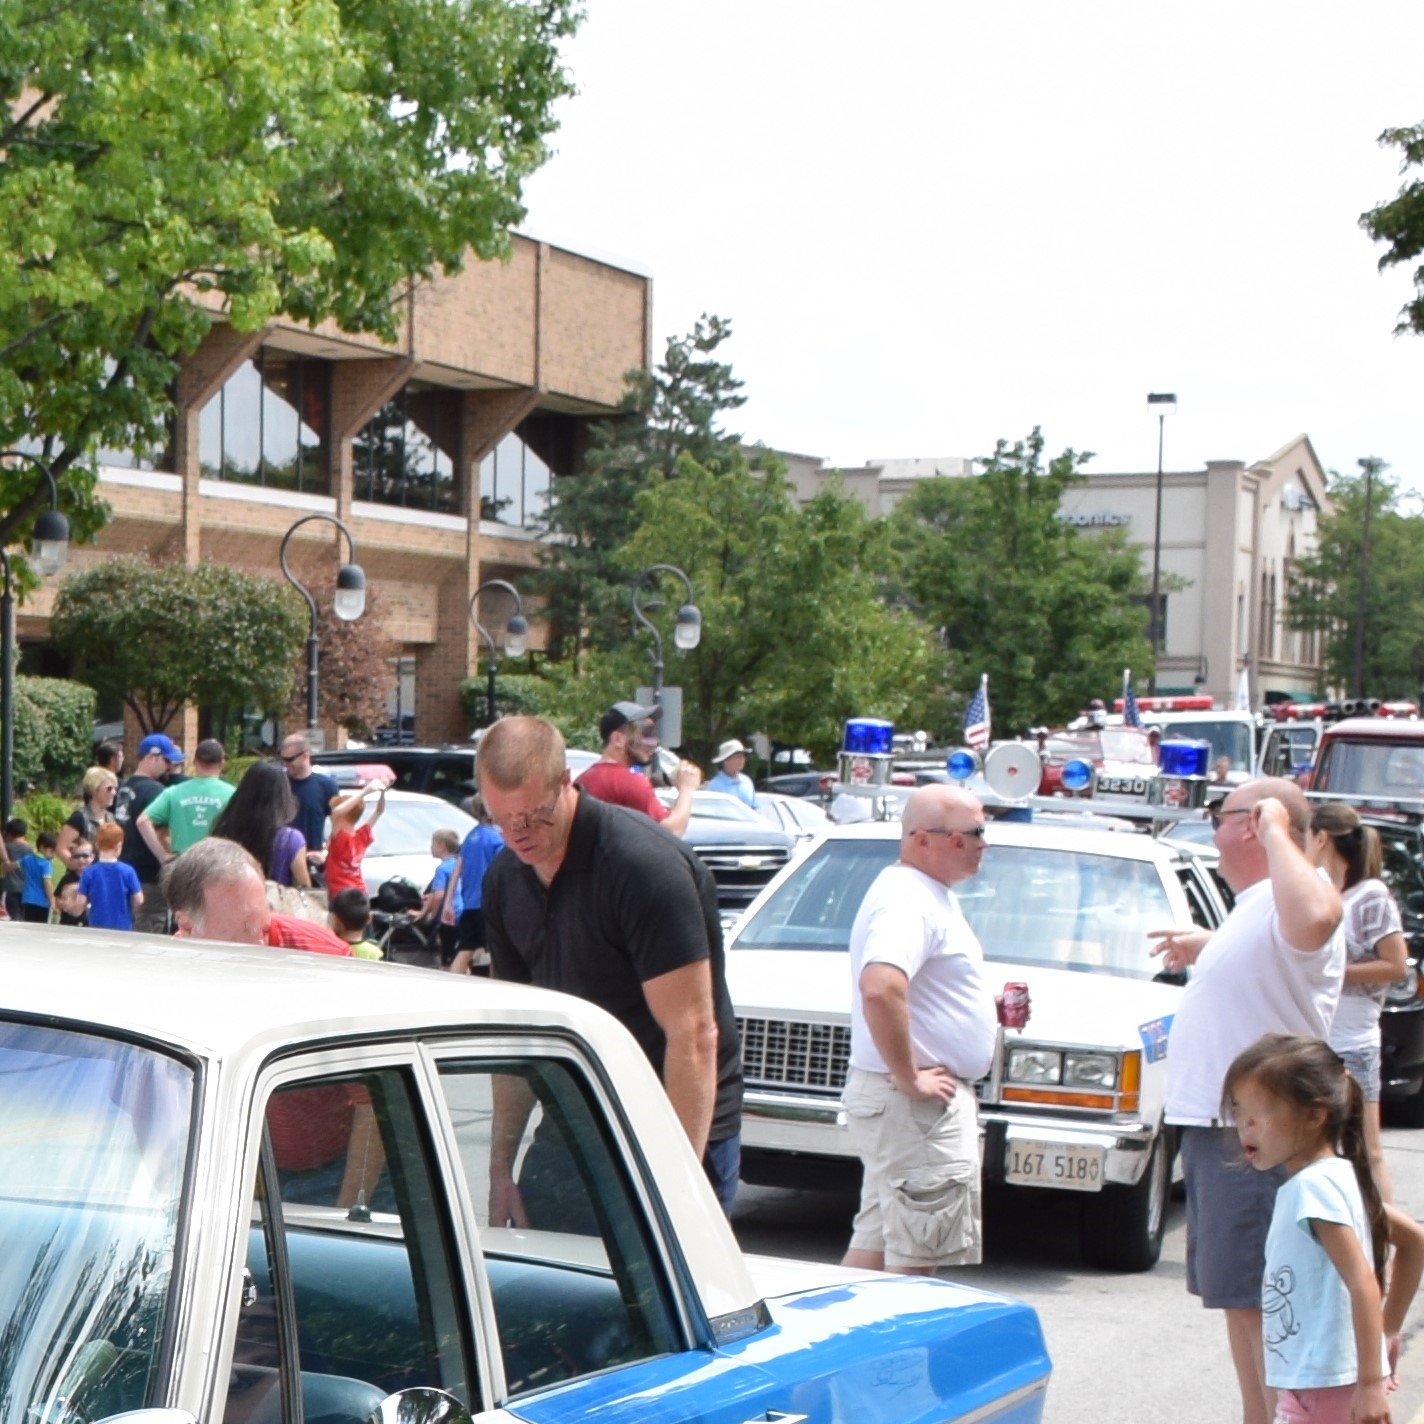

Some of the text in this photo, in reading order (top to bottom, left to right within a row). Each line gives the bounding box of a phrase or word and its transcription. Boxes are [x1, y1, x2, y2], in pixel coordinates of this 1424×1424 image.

[1098, 777, 1145, 793] 3230
[1012, 1152, 1088, 1180] 167 518
